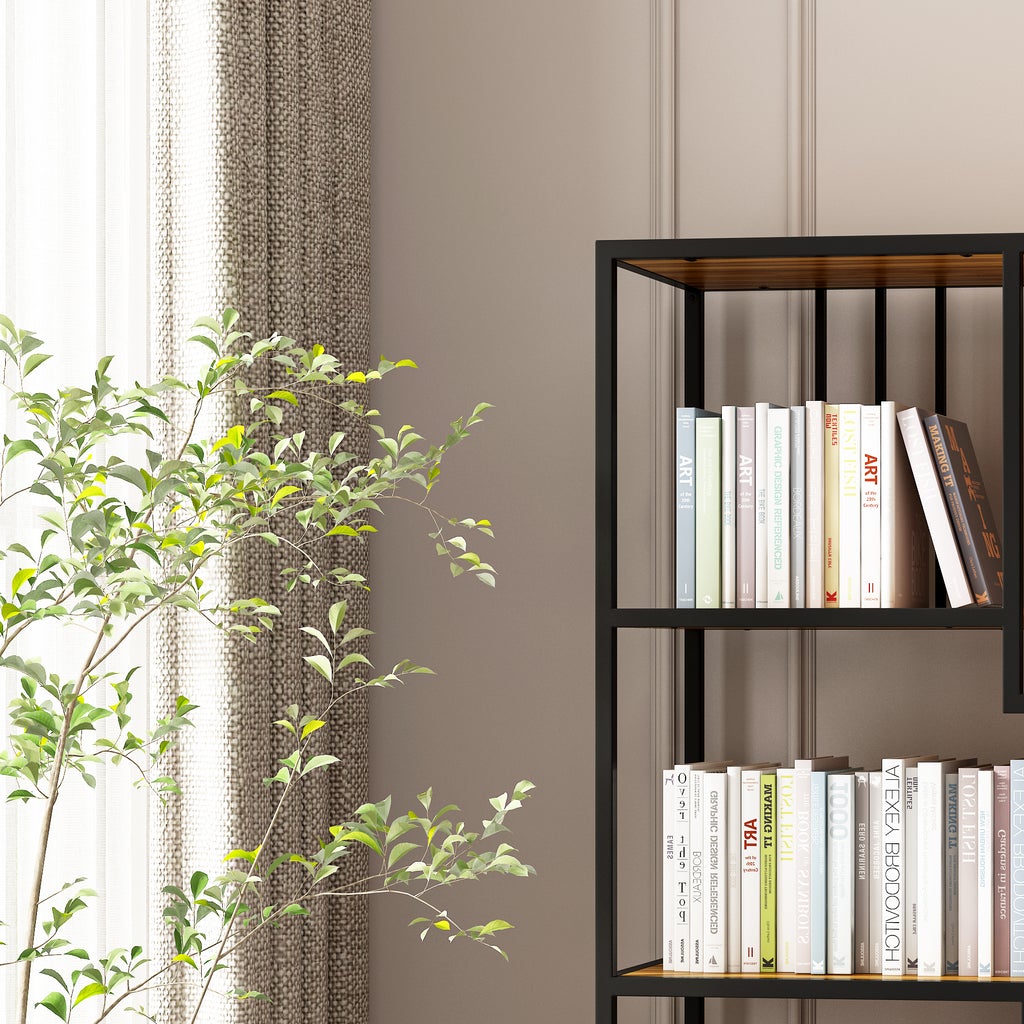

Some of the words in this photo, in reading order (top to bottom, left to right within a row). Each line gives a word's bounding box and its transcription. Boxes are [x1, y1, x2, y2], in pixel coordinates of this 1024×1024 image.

[774, 425, 782, 468] GRAPHIC
[843, 410, 857, 455] LOST
[680, 455, 692, 486] ART
[740, 454, 752, 486] ART
[864, 454, 877, 485] ART
[928, 424, 950, 473] MAKING
[943, 474, 954, 487] IT
[774, 471, 782, 505] DESIGN
[843, 459, 857, 497] FISH
[774, 508, 782, 570] REFERENCED
